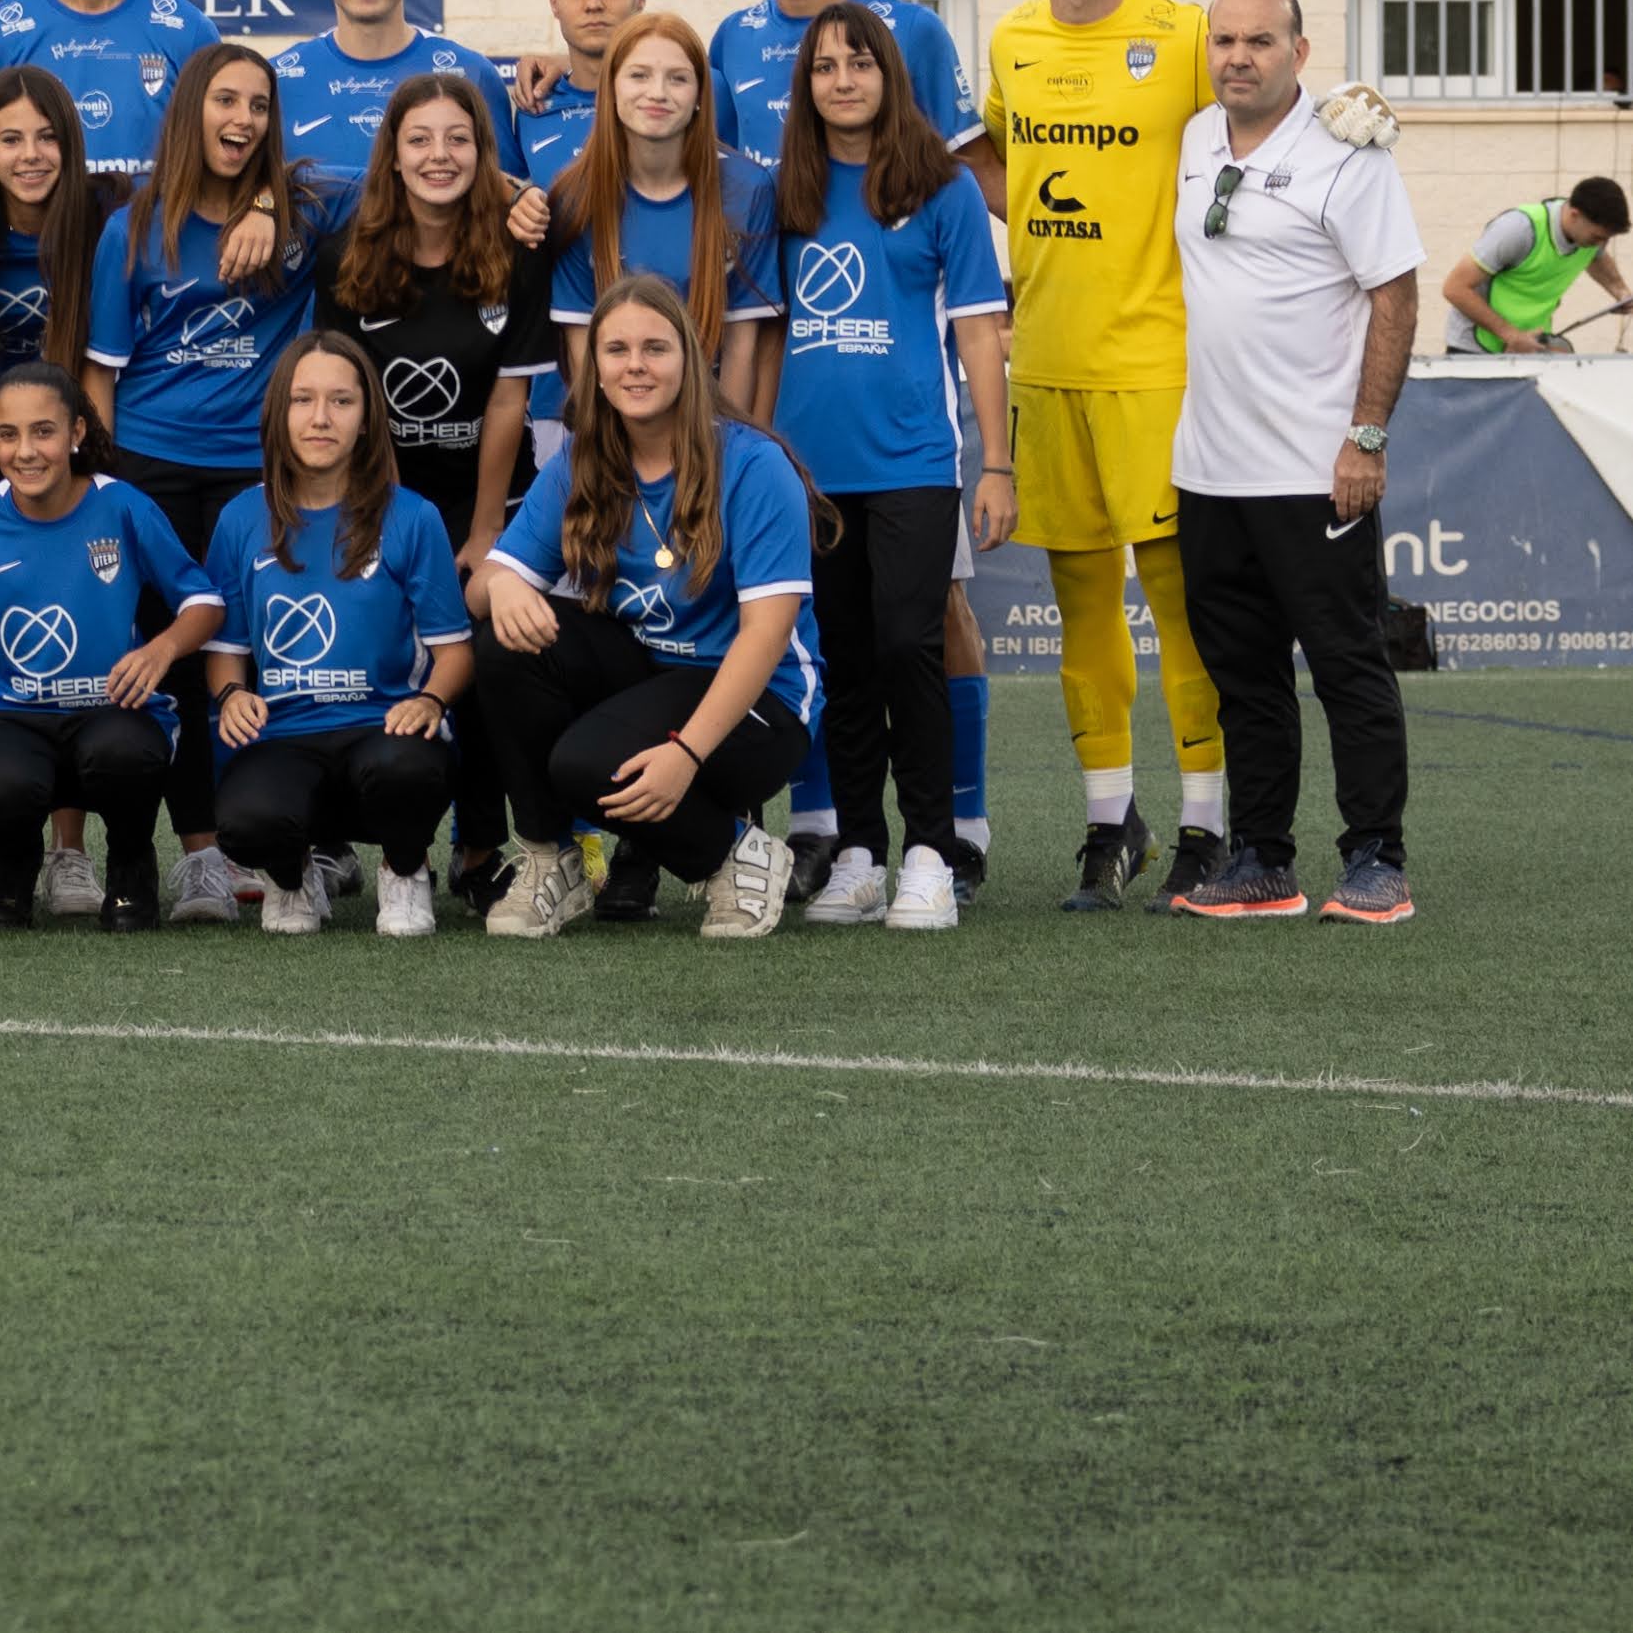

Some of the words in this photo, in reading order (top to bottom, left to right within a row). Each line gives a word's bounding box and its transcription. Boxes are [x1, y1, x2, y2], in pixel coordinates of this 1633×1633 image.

[1011, 111, 1140, 151] Alcampo
[1027, 218, 1103, 240] CINTASA
[791, 319, 889, 339] SPHERE
[837, 343, 889, 355] ESPAÑA
[92, 551, 121, 568] UTEBO
[1423, 600, 1562, 624] NEGOCIOS
[992, 637, 1022, 655] EN
[1028, 637, 1062, 655] IBIZ
[1558, 631, 1633, 651] 900812
[10, 676, 110, 696] SPHERE
[263, 668, 367, 688] SPHERE
[313, 693, 368, 704] ESPAÑA
